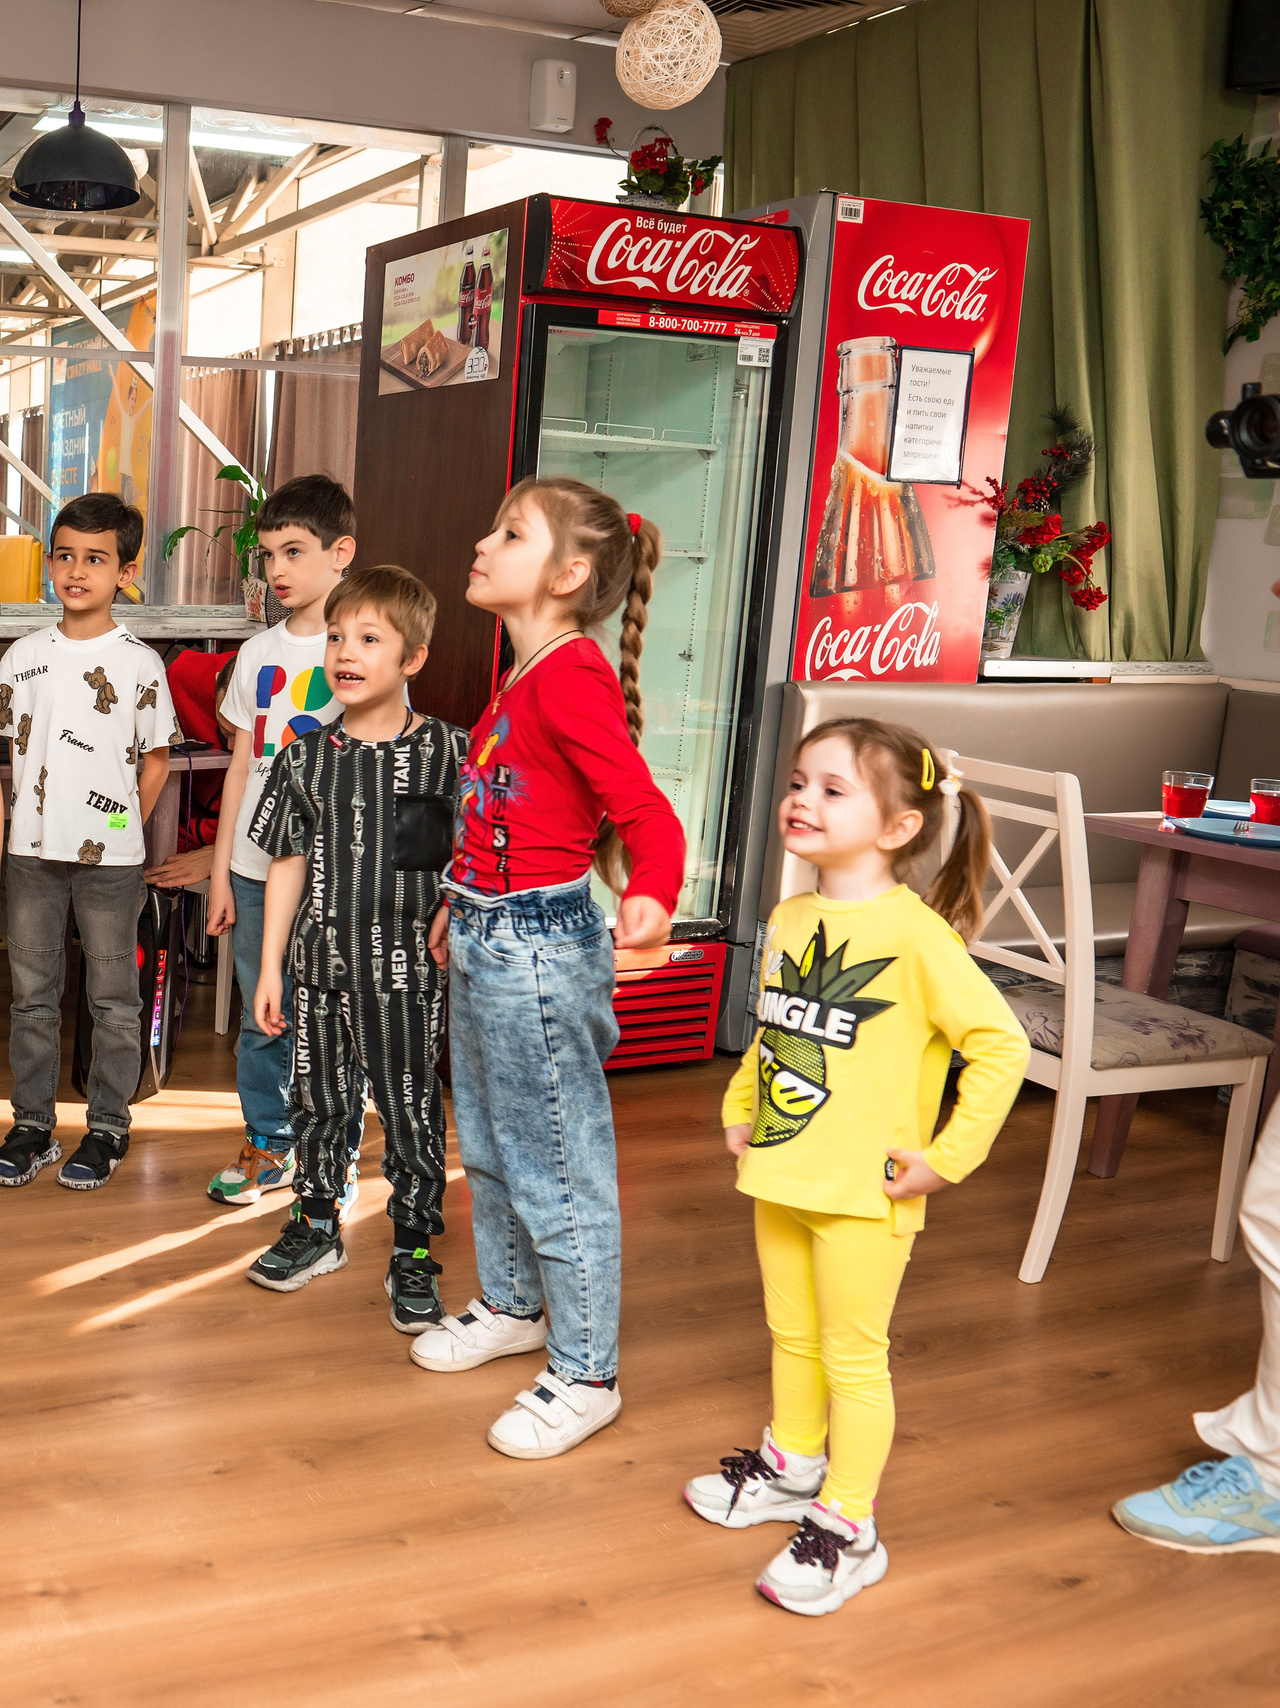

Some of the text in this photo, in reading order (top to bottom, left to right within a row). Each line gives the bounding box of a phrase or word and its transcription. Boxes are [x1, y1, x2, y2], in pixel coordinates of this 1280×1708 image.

[635, 216, 687, 234] Всё будет
[586, 217, 761, 299] Coca-Cola
[394, 273, 415, 286] КОМБО
[857, 254, 999, 322] Coca-Cola
[648, 316, 728, 334] 8-800-700-7777
[911, 363, 952, 376] Уважаемые
[909, 379, 931, 387] гости!
[908, 393, 955, 407] Есть свою еду
[906, 408, 947, 419] и пить свои
[905, 423, 934, 432] напитки
[805, 601, 941, 682] Coca-Cola
[59, 729, 95, 753] France
[312, 834, 326, 923] UNTAMED
[371, 924, 383, 956] GLVR
[297, 986, 311, 1075] UNTAMED
[337, 1064, 348, 1092] GLVR
[402, 1073, 413, 1105] GLVR
